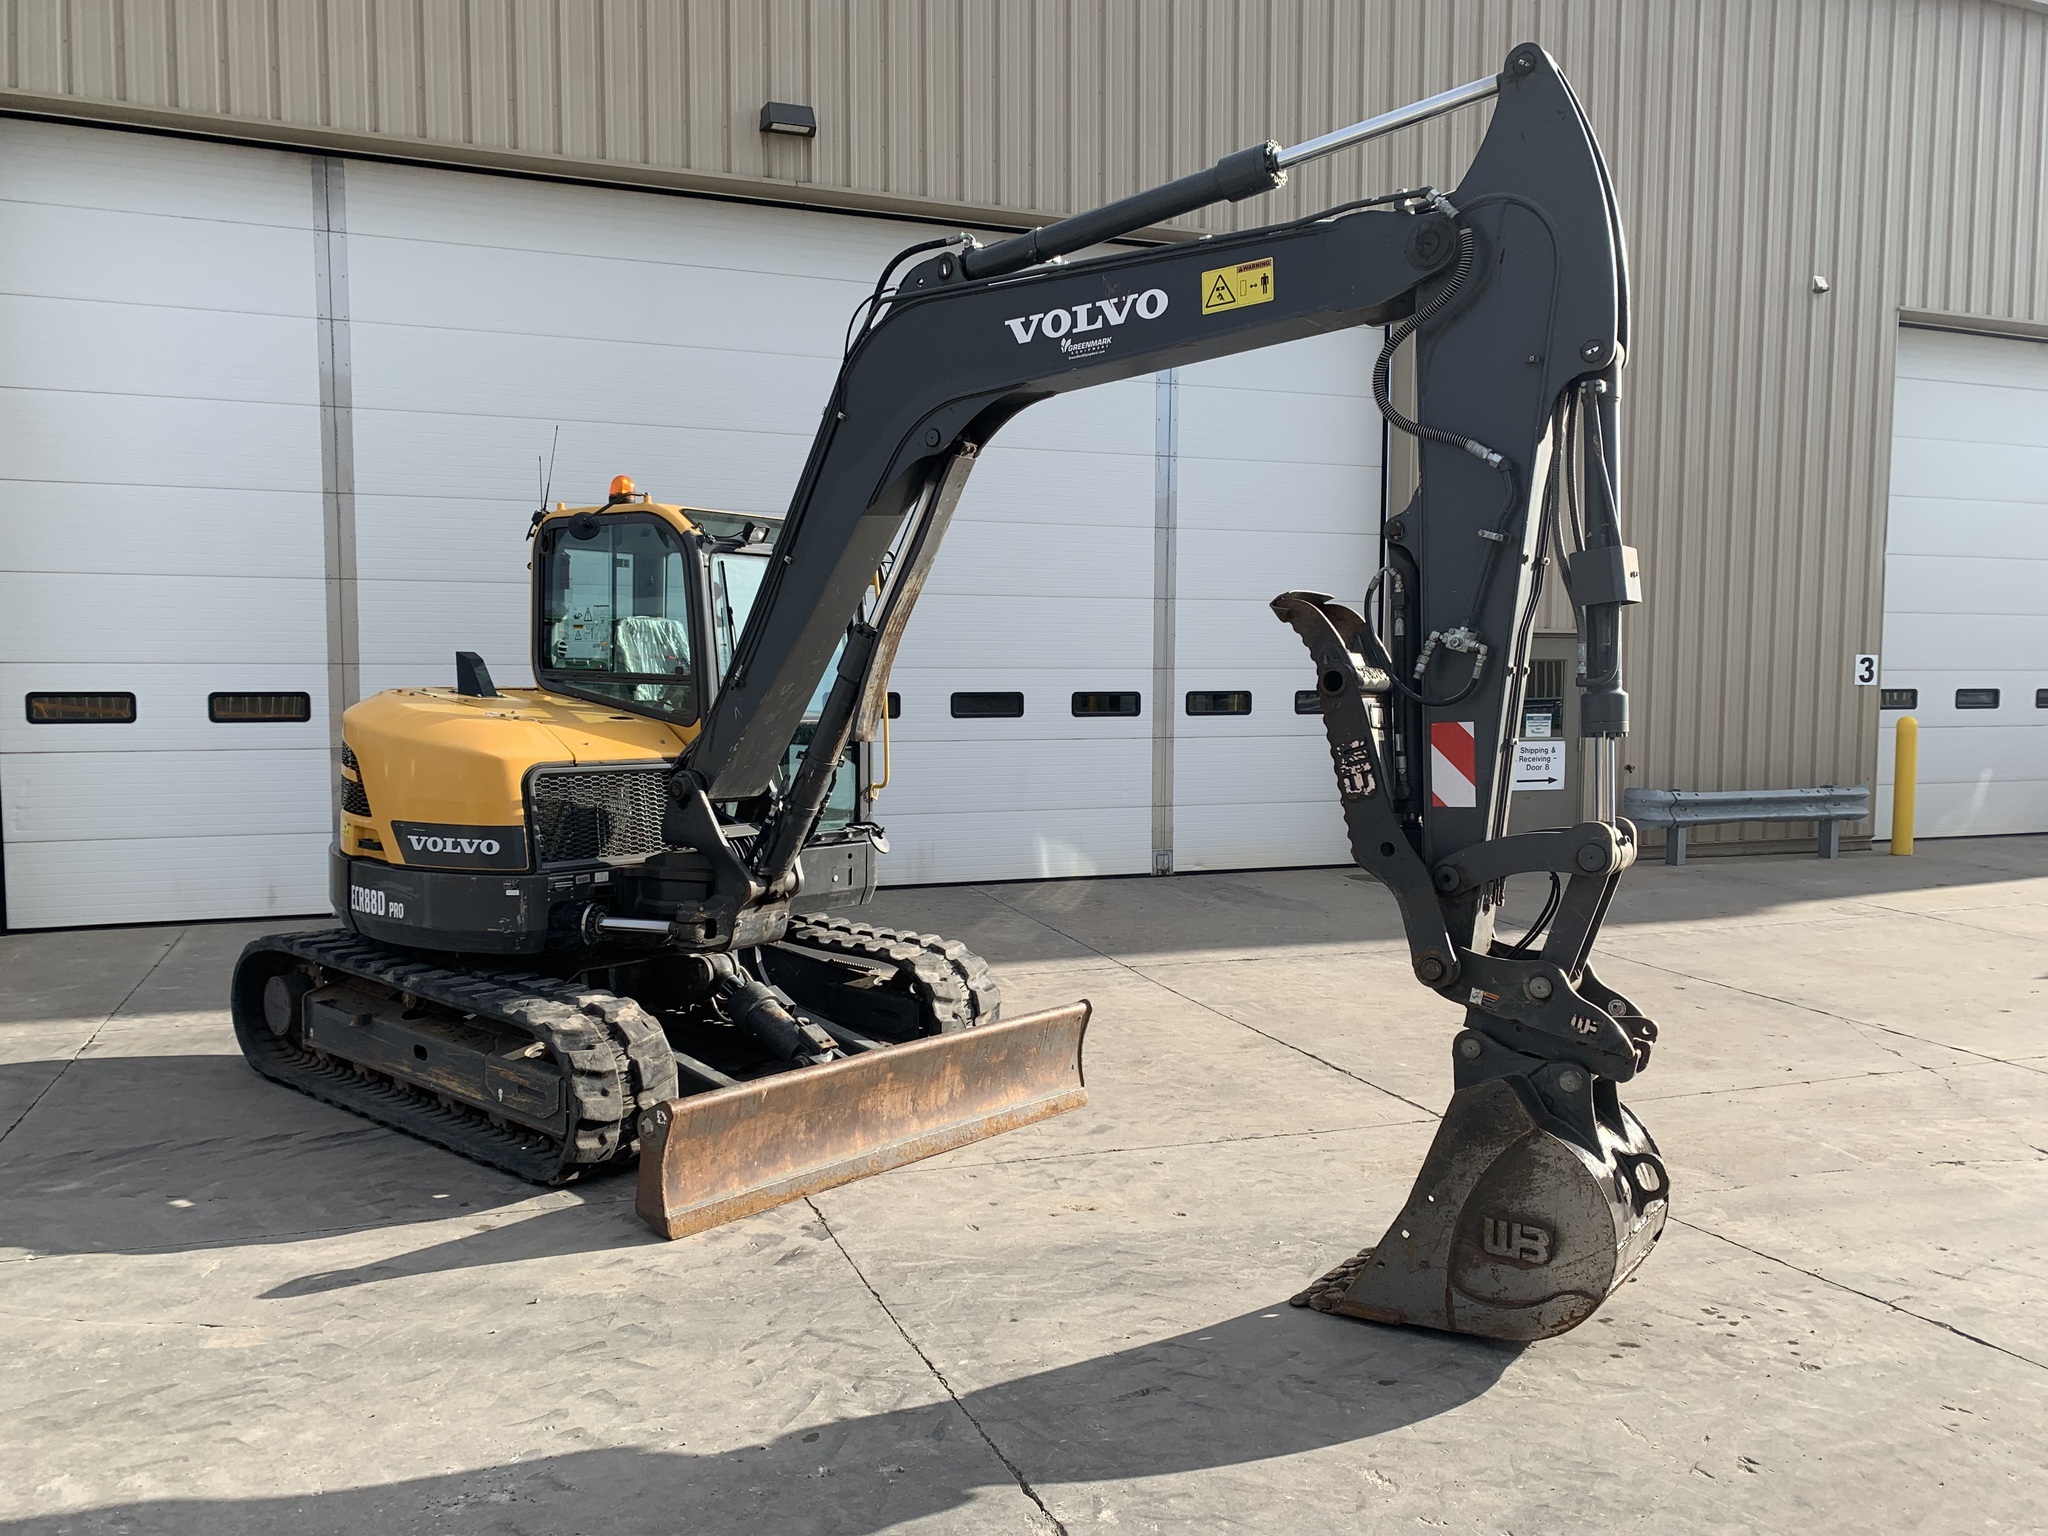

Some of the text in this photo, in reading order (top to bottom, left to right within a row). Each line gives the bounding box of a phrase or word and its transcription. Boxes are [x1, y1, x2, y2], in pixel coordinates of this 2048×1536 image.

[1242, 259, 1271, 271] WARNING
[1005, 288, 1169, 344] VOLVO
[1068, 336, 1112, 352] GREENMARK
[1858, 657, 1875, 683] 3
[1520, 747, 1549, 755] Shipping
[407, 835, 500, 855] VOLVO
[351, 884, 404, 919] ECR88D PRO
[1483, 1216, 1550, 1265] WB
